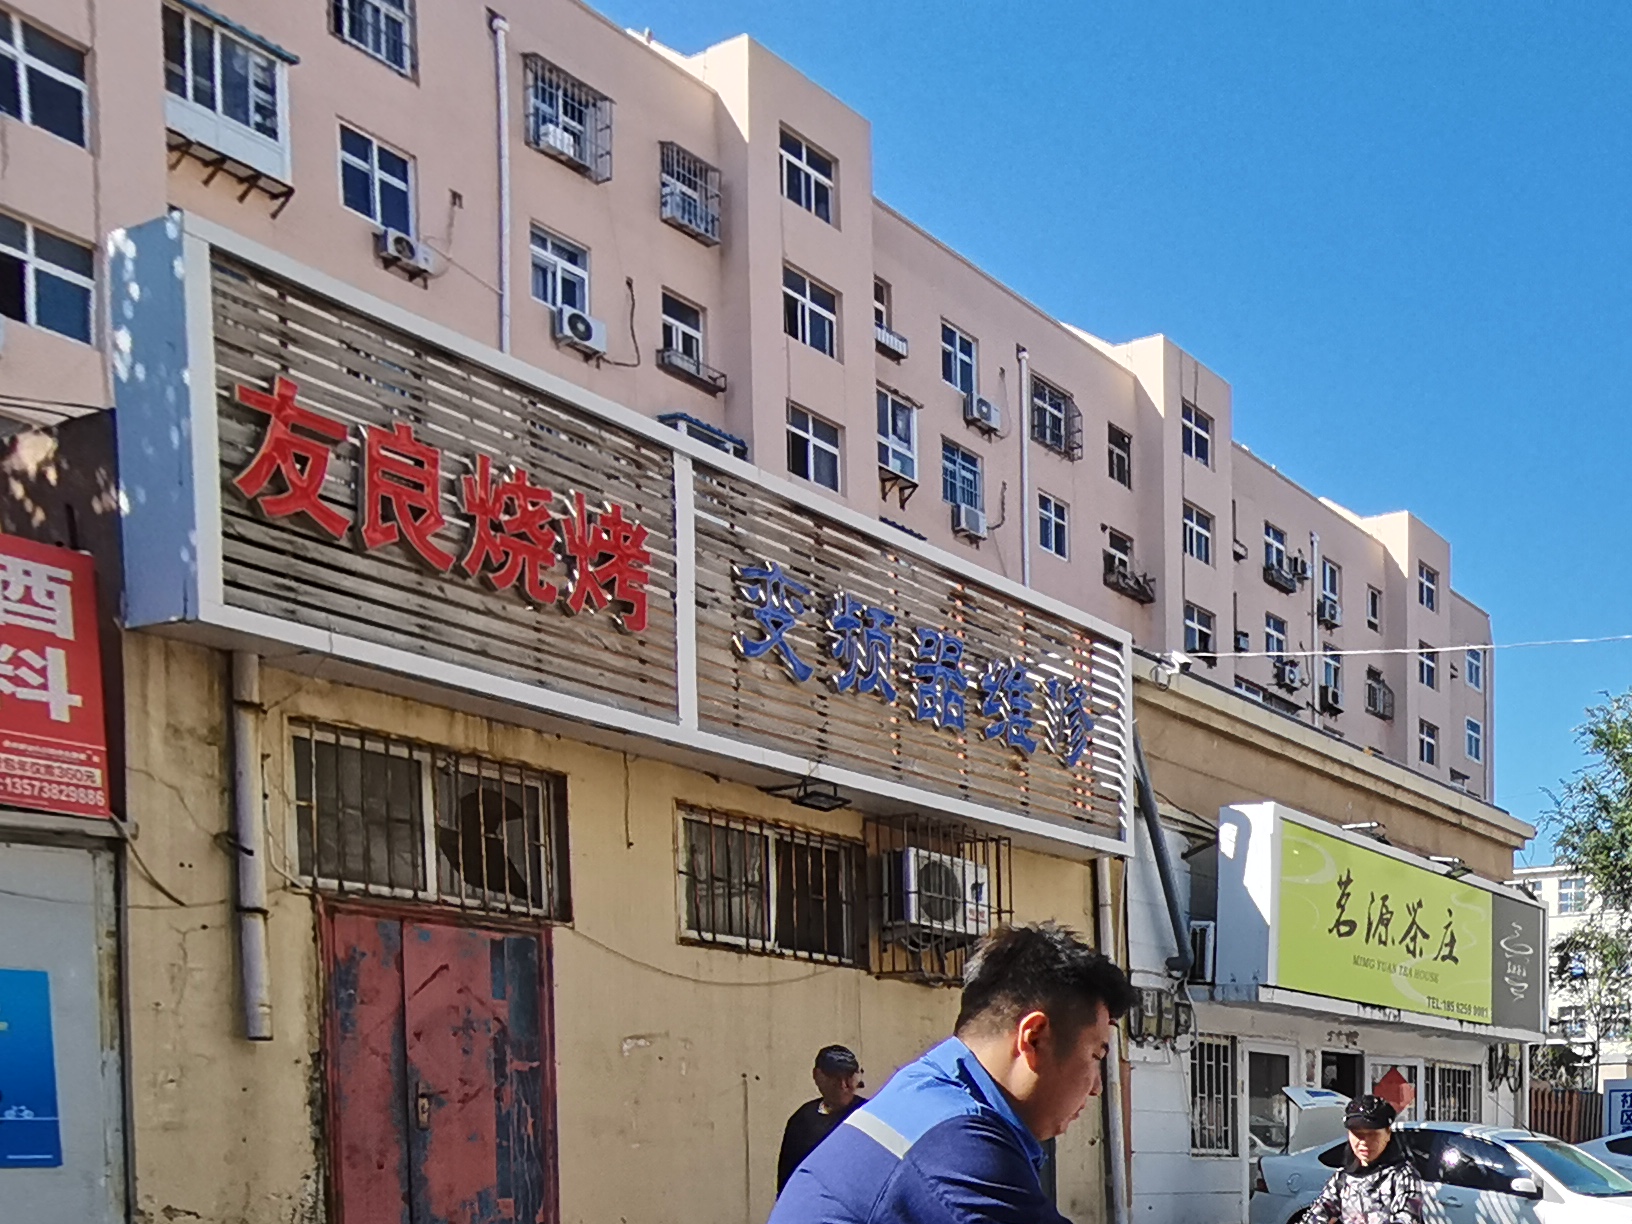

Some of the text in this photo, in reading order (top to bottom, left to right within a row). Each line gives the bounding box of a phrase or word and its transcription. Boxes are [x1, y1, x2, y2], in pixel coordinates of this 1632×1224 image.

[233, 374, 652, 633] 友良烧烤
[735, 561, 1094, 768] 变频器维修
[1328, 868, 1460, 965] 茗源茶庄
[1399, 965, 1413, 979] TEA
[1414, 970, 1440, 983] HOUSE
